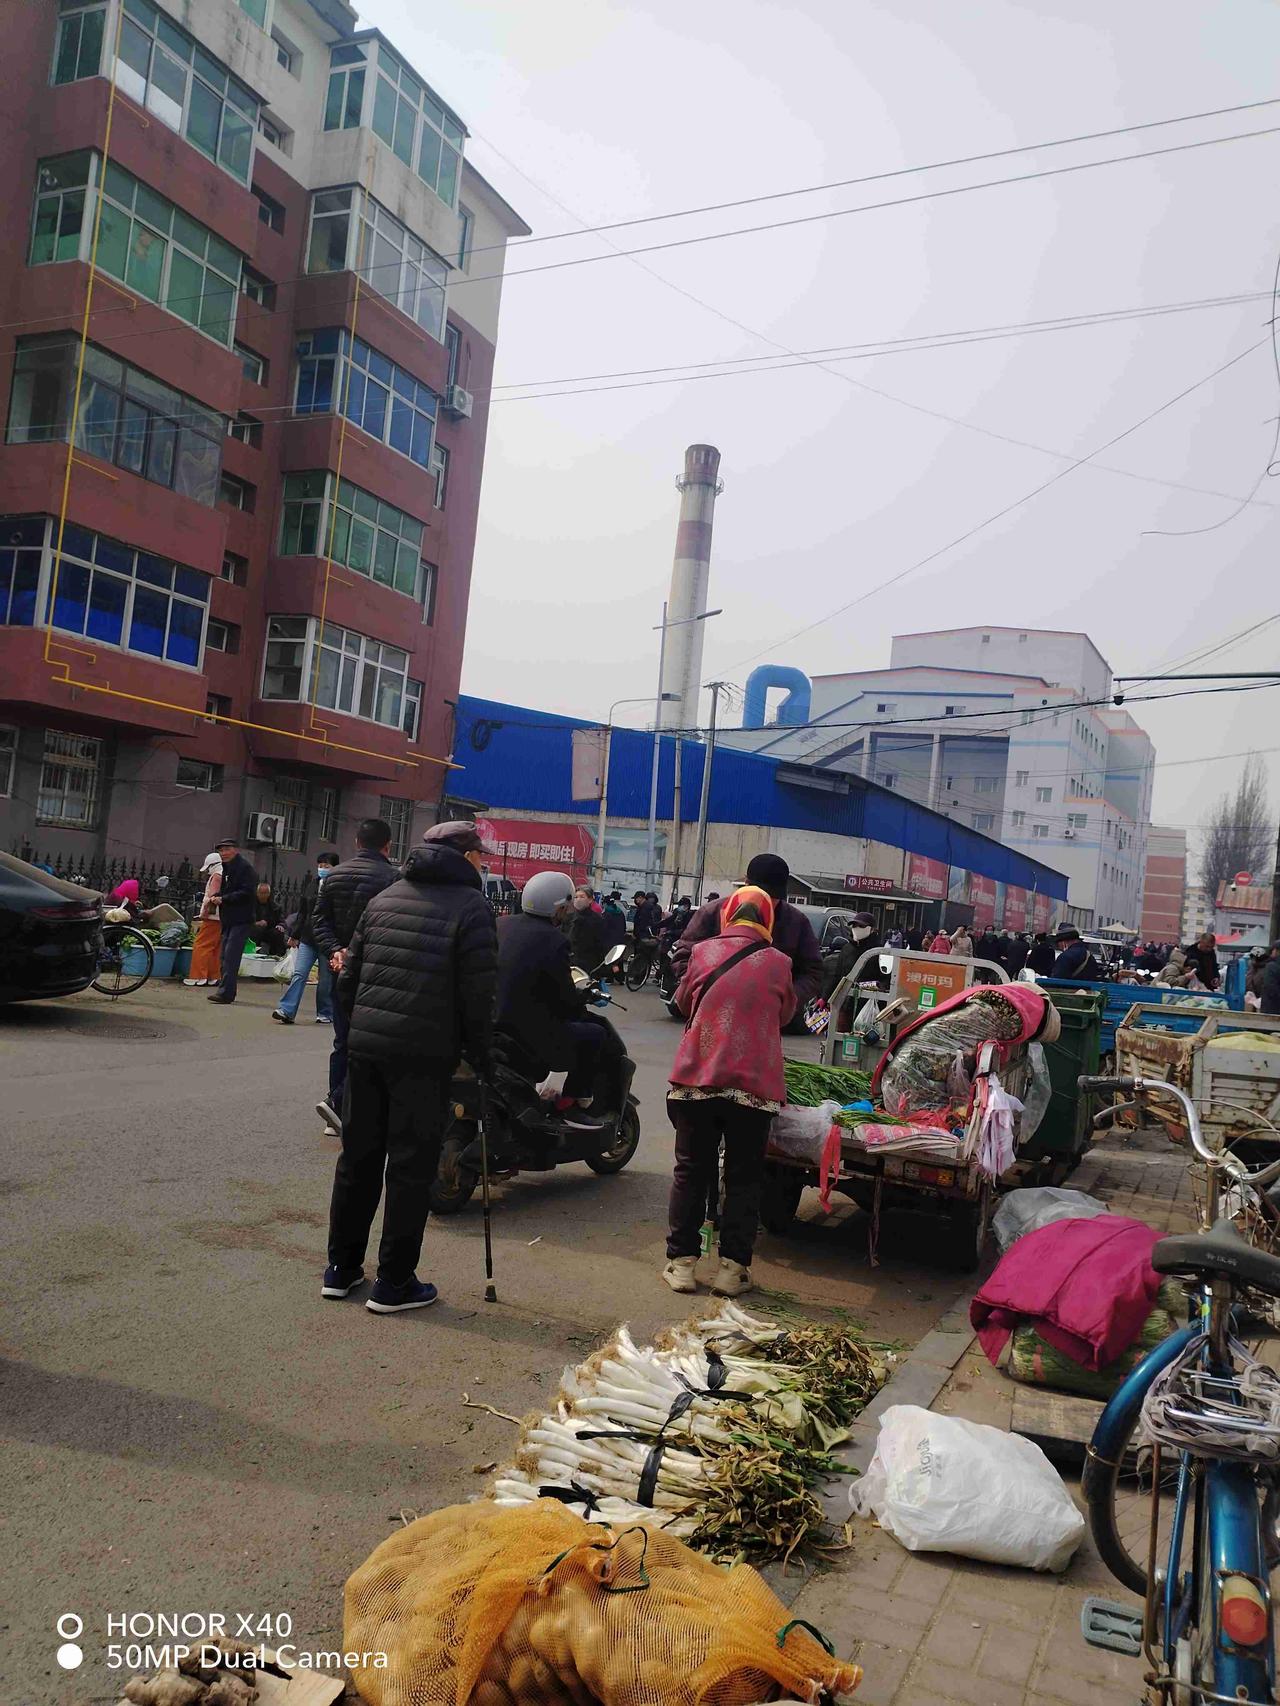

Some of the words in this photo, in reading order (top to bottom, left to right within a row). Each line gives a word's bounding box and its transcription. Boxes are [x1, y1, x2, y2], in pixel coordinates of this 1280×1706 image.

[529, 842, 575, 862] 即买即住!
[861, 878, 892, 888] 公共卫生间
